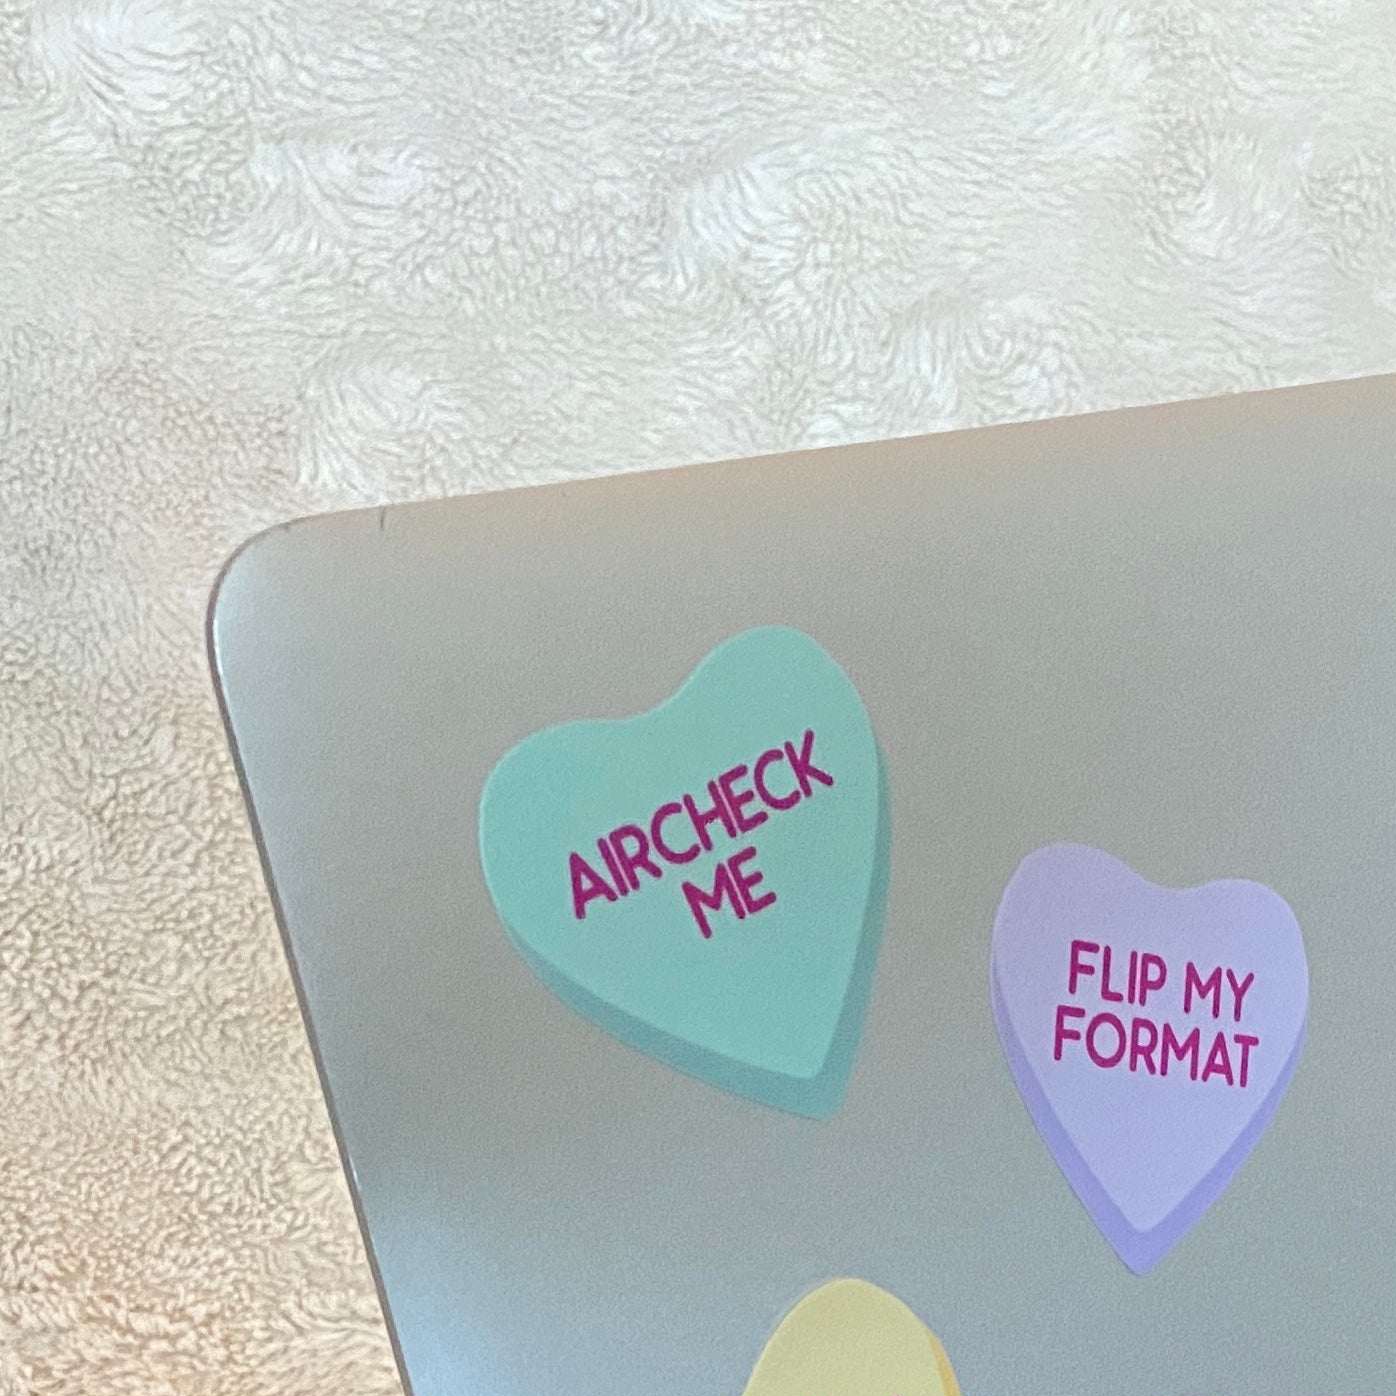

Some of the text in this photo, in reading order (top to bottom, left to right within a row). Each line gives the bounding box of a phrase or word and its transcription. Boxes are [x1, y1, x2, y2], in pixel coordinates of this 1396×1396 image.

[569, 729, 833, 918] AIRCHECK
[682, 847, 776, 937] ME
[1067, 939, 1256, 1022] FLIP MY
[1053, 1004, 1260, 1088] FORMAT
